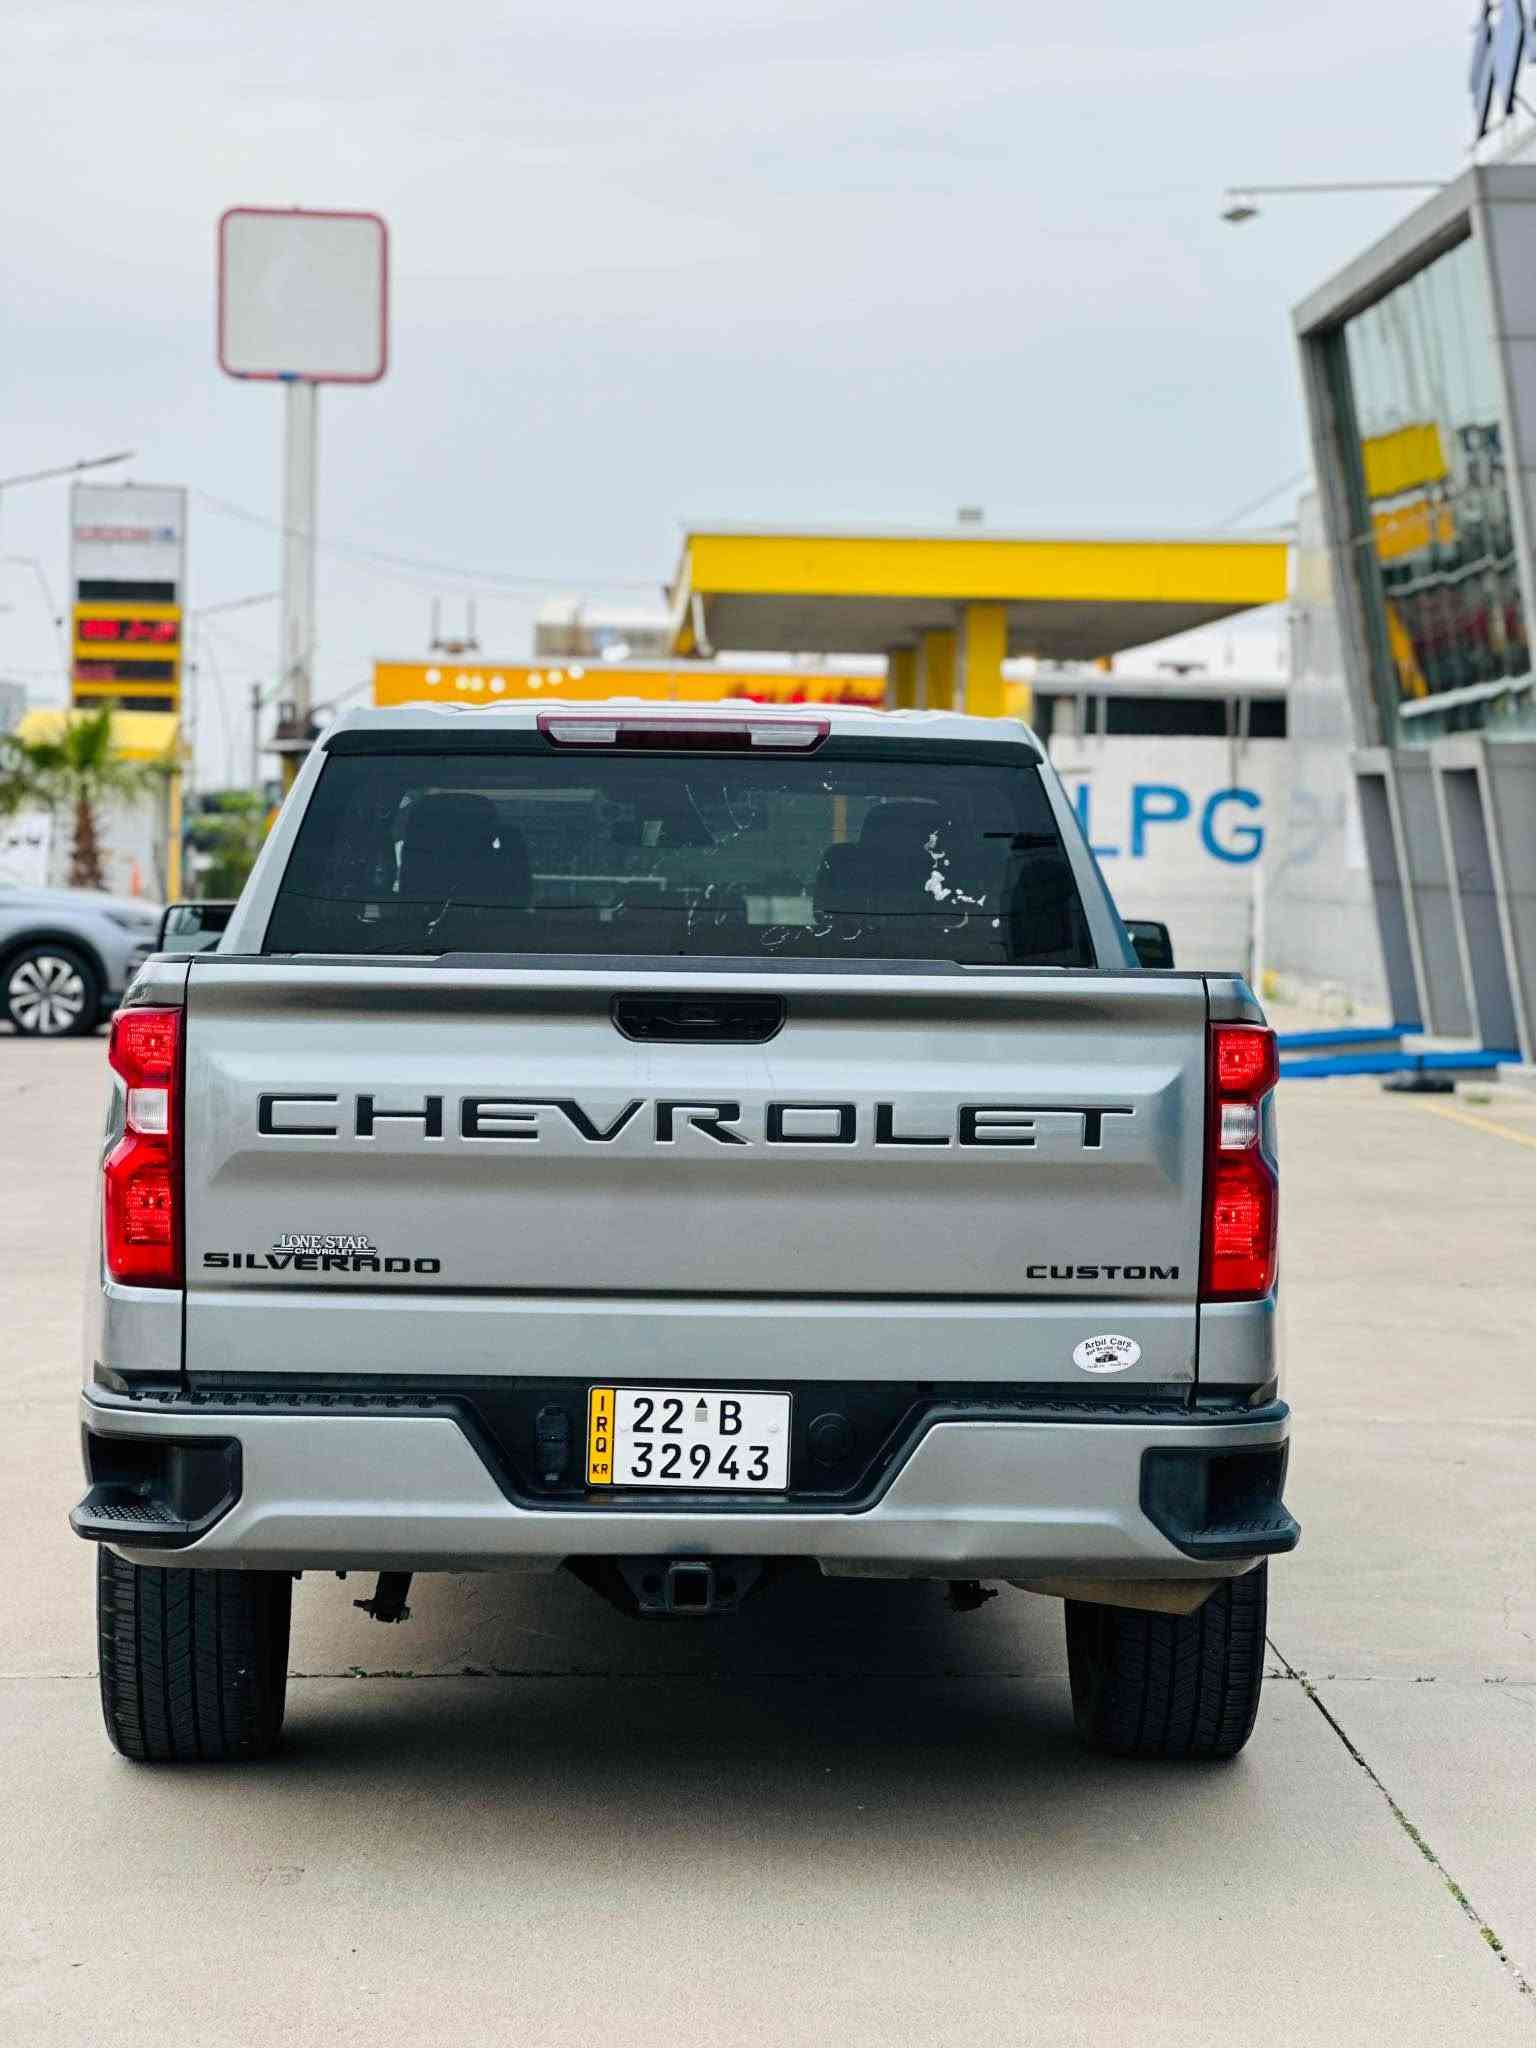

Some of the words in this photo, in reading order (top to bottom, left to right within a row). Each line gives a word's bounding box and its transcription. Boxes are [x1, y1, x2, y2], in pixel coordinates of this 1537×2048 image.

[1077, 783, 1264, 864] LPG
[256, 1092, 1135, 1149] CHEVROLET
[280, 1234, 321, 1248] LONE
[325, 1235, 368, 1249] STAR
[294, 1248, 354, 1256] CHEVROLET
[203, 1252, 441, 1274] SILVERADO
[1026, 1265, 1180, 1280] CUSTOM
[632, 1397, 684, 1434] 22
[719, 1400, 742, 1436] B
[592, 1463, 608, 1475] KR
[631, 1441, 769, 1481] 32943
